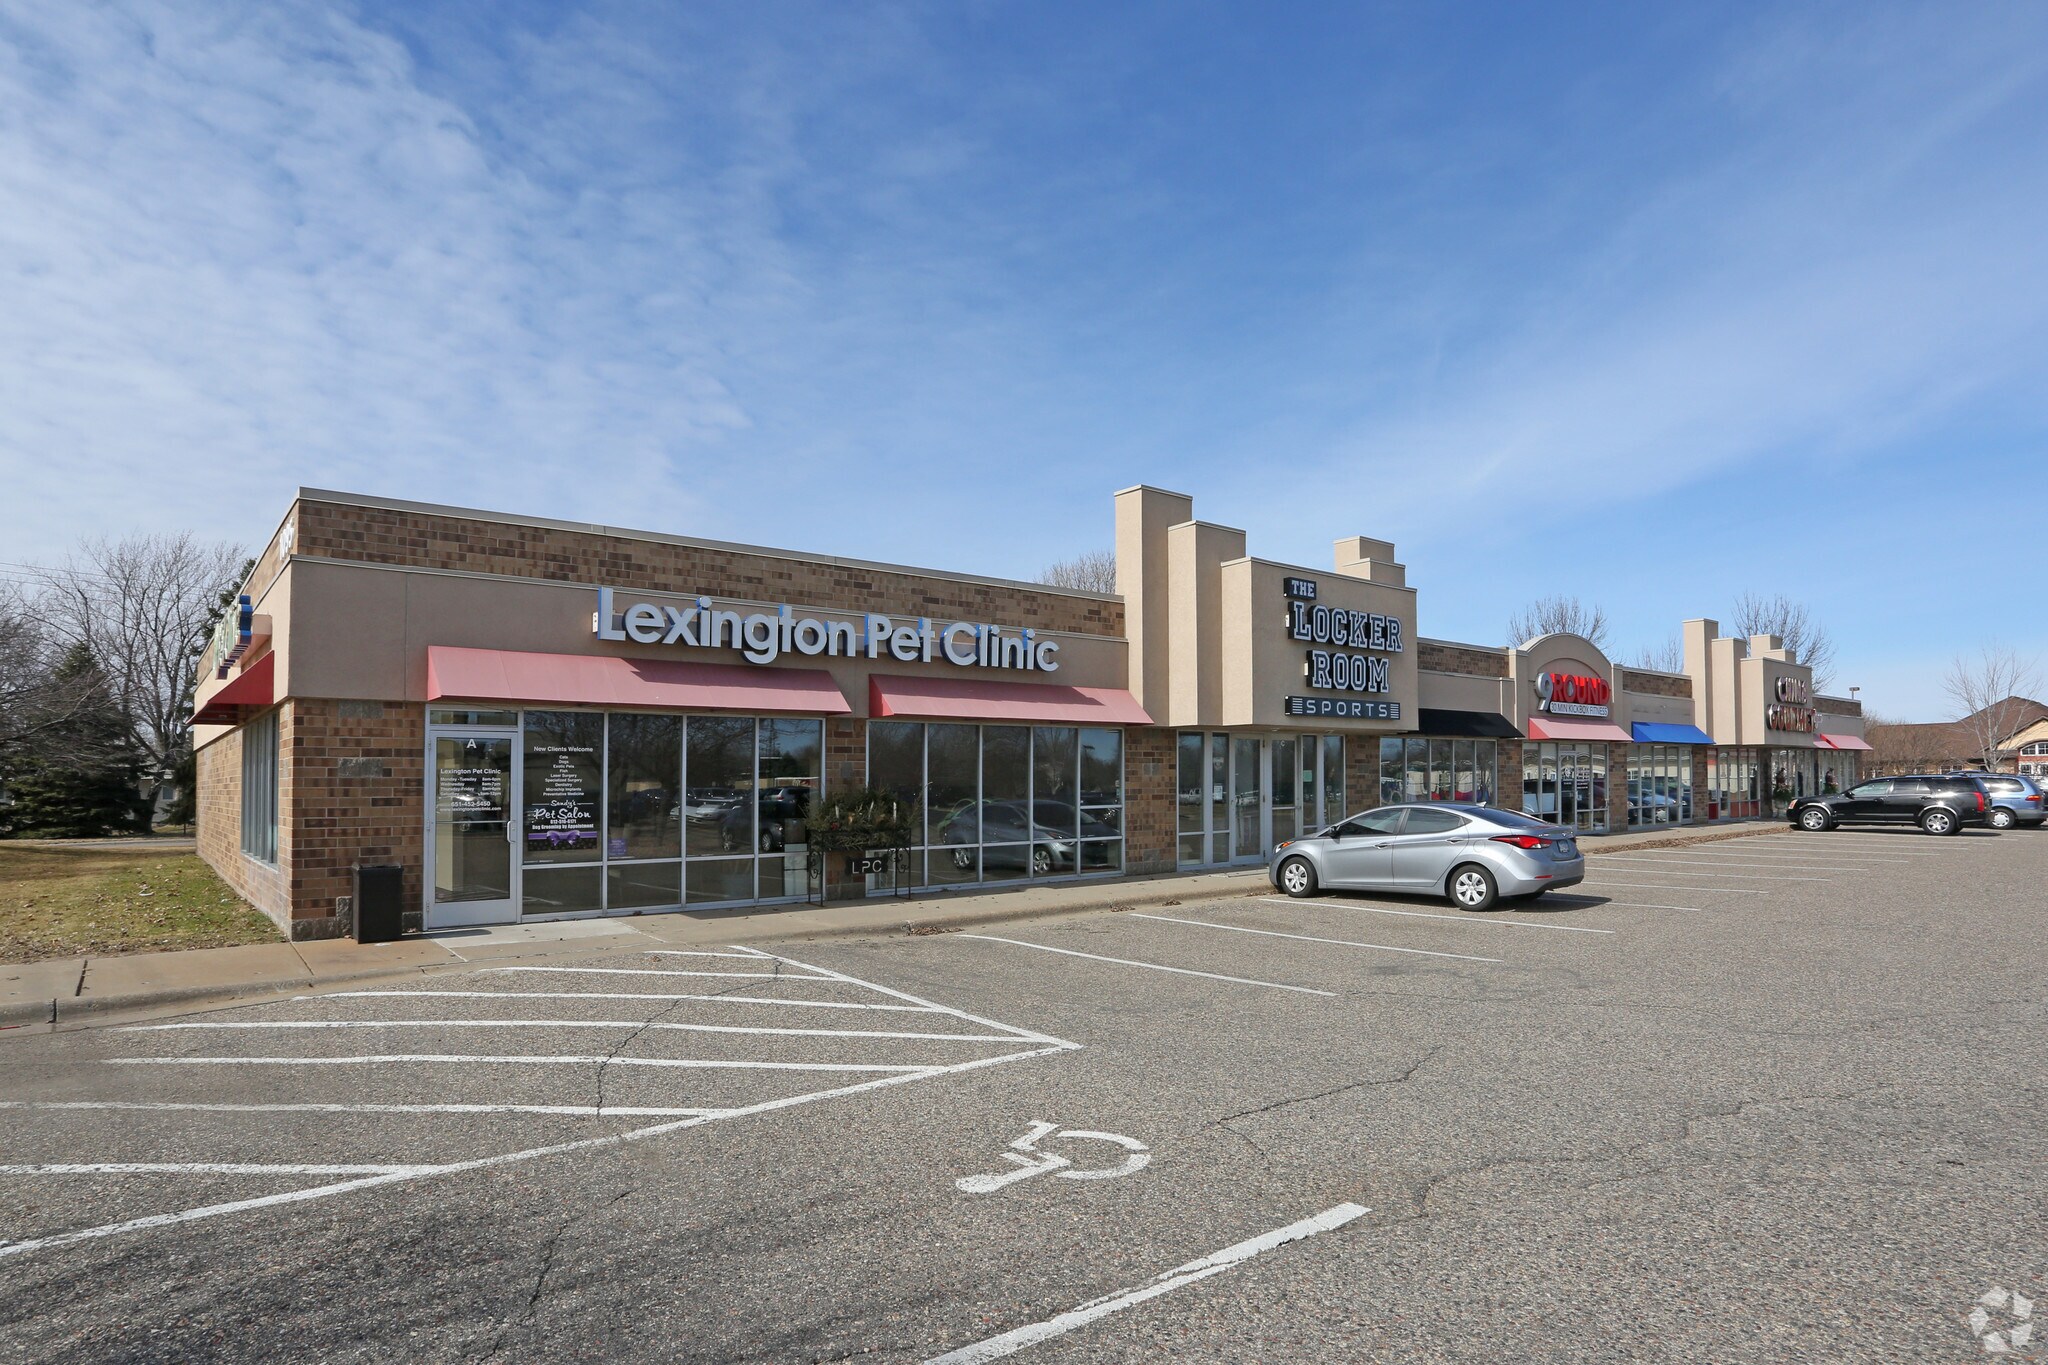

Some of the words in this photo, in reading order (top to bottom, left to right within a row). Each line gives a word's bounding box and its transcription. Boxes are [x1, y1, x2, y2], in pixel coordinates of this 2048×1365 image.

[1291, 580, 1315, 598] THE
[597, 586, 857, 665] Lexington
[864, 612, 936, 663] Pet
[940, 621, 1060, 673] Clinic
[1292, 600, 1404, 653] LOCKER
[1311, 650, 1389, 693] ROOM
[1536, 672, 1610, 711] 9ROUND
[1306, 699, 1388, 717] SPORTS
[1557, 703, 1568, 713] MIN
[1568, 704, 1590, 715] KICKBOX
[1590, 706, 1608, 716] FITNESS
[466, 739, 477, 749] A
[533, 807, 557, 819] Pet
[557, 806, 592, 819] Salon
[550, 799, 576, 808] Sandy's
[852, 860, 882, 874] LPC
